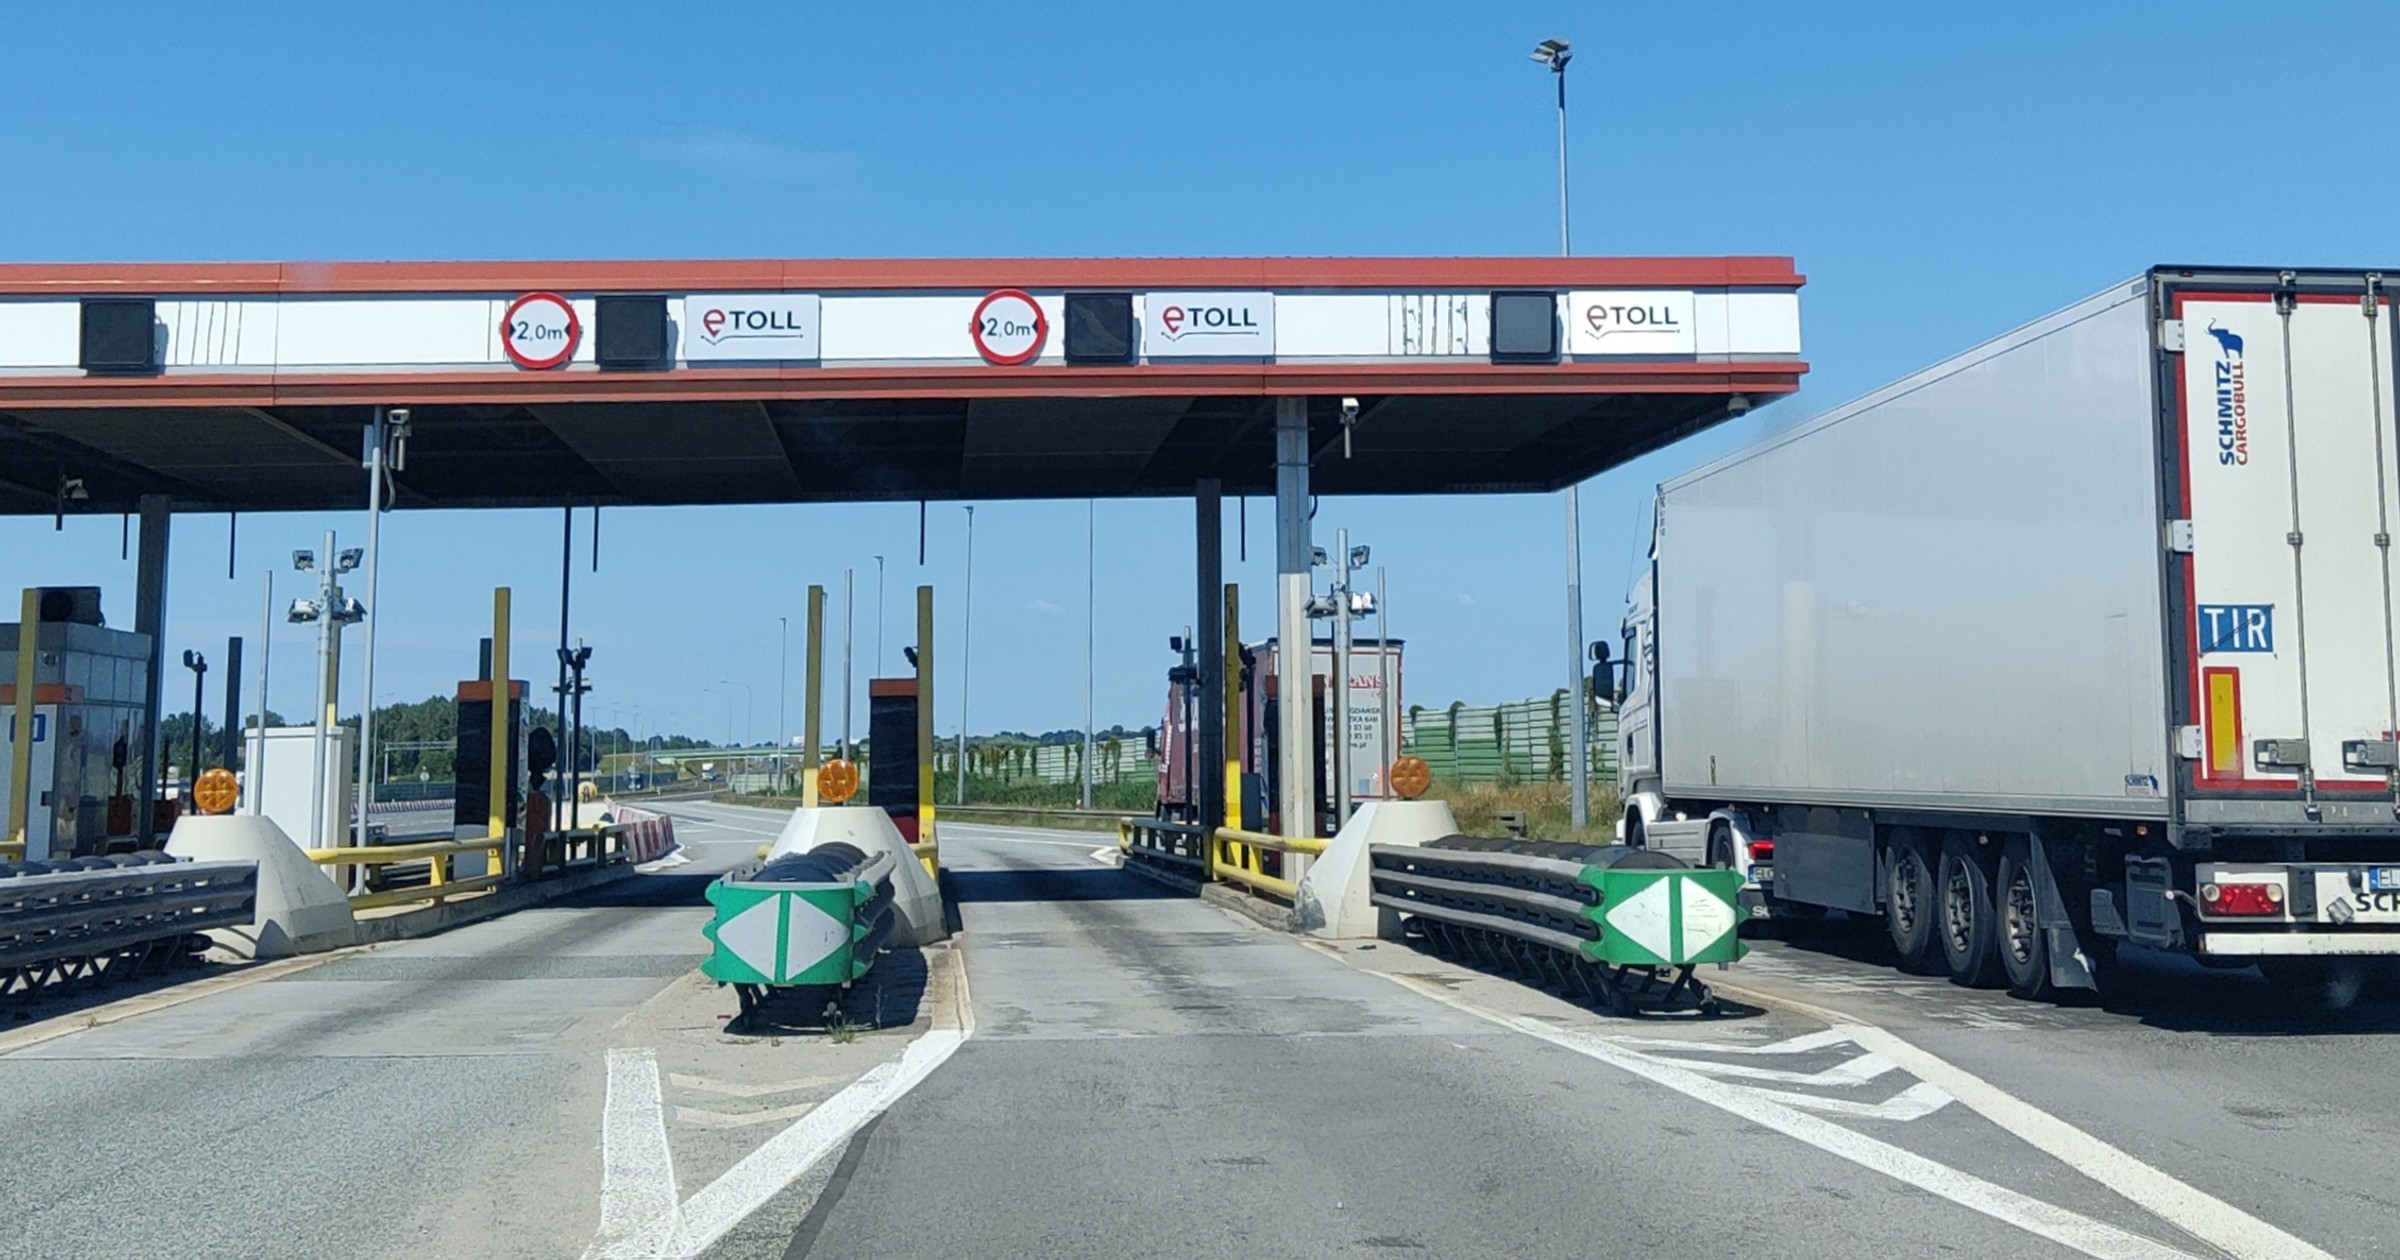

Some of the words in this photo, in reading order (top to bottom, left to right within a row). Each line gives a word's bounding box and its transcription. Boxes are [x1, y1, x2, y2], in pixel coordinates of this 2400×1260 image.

[2215, 360, 2235, 466] SCHMITZ
[2232, 361, 2248, 466] CARGOBULL
[2204, 608, 2267, 648] TIR
